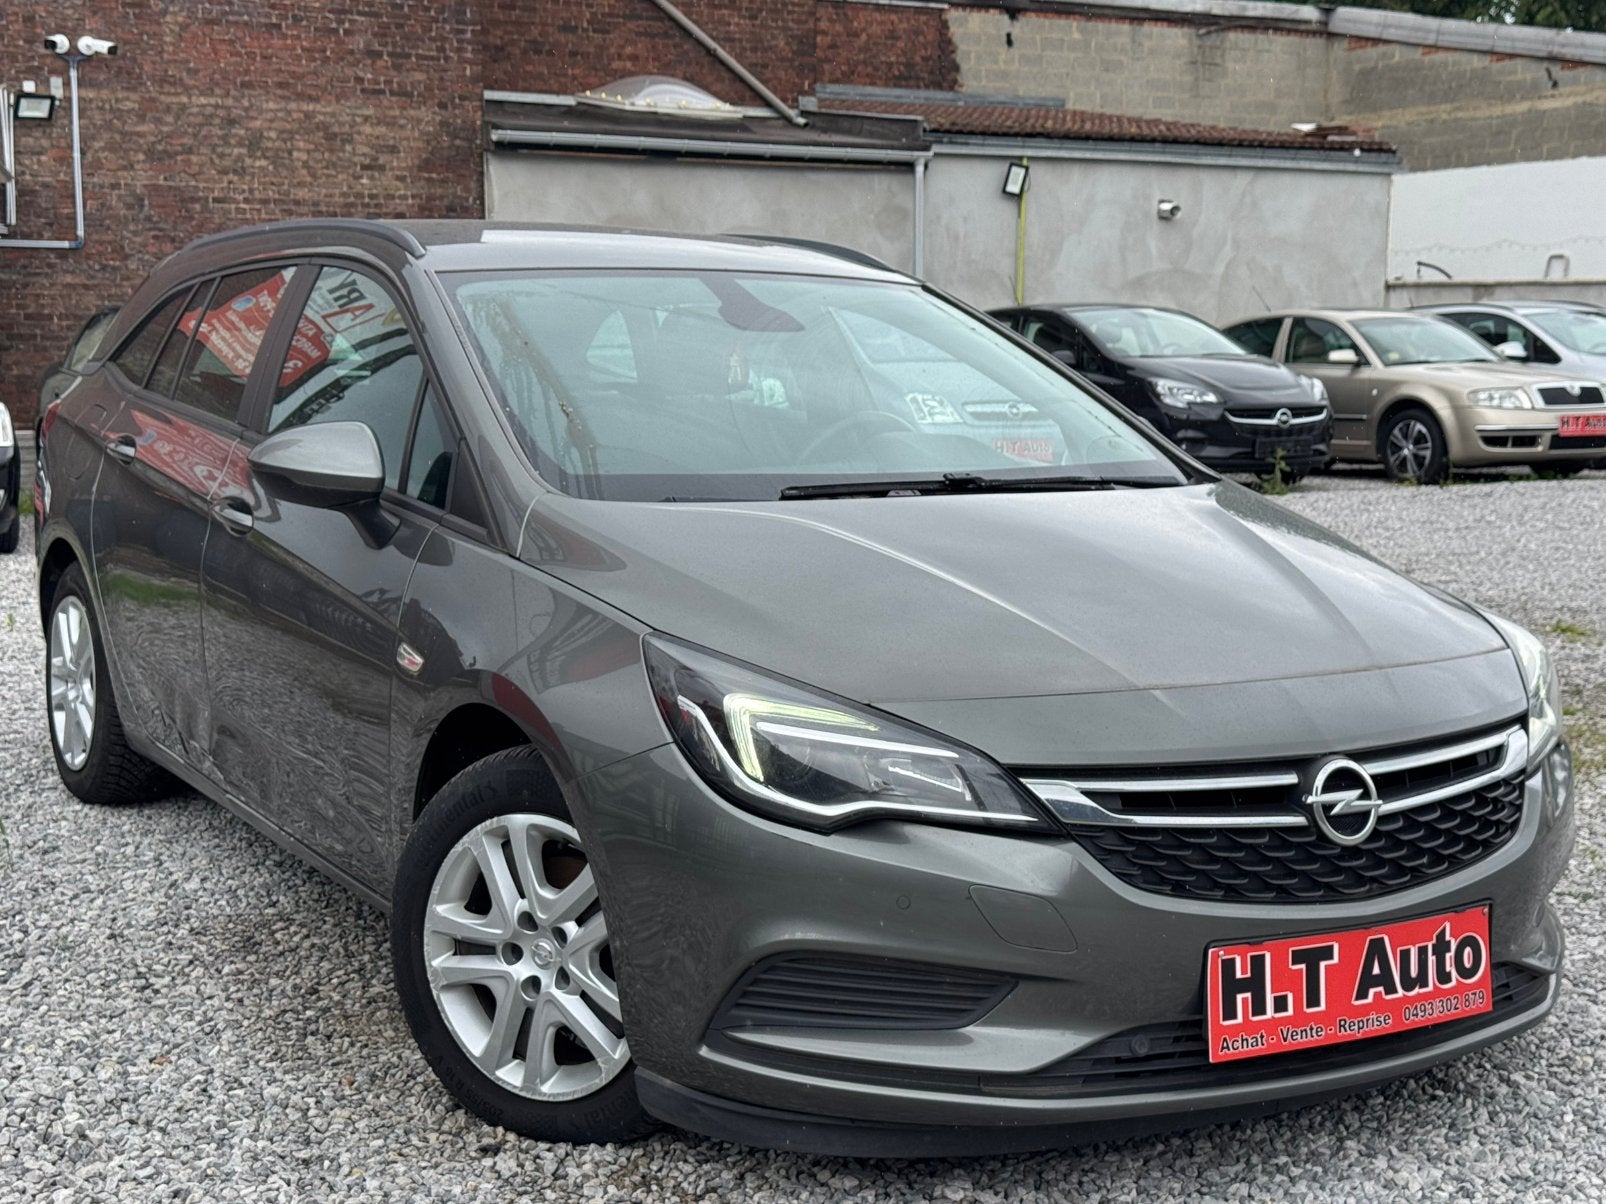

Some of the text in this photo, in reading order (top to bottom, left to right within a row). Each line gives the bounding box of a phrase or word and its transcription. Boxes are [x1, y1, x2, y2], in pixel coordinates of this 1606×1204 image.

[1220, 920, 1486, 1025] H.T Auto
[1219, 1030, 1265, 1054] Achat
[1279, 1022, 1324, 1044] Vente
[1338, 1011, 1392, 1035] Reprise
[1464, 990, 1486, 1010] 879
